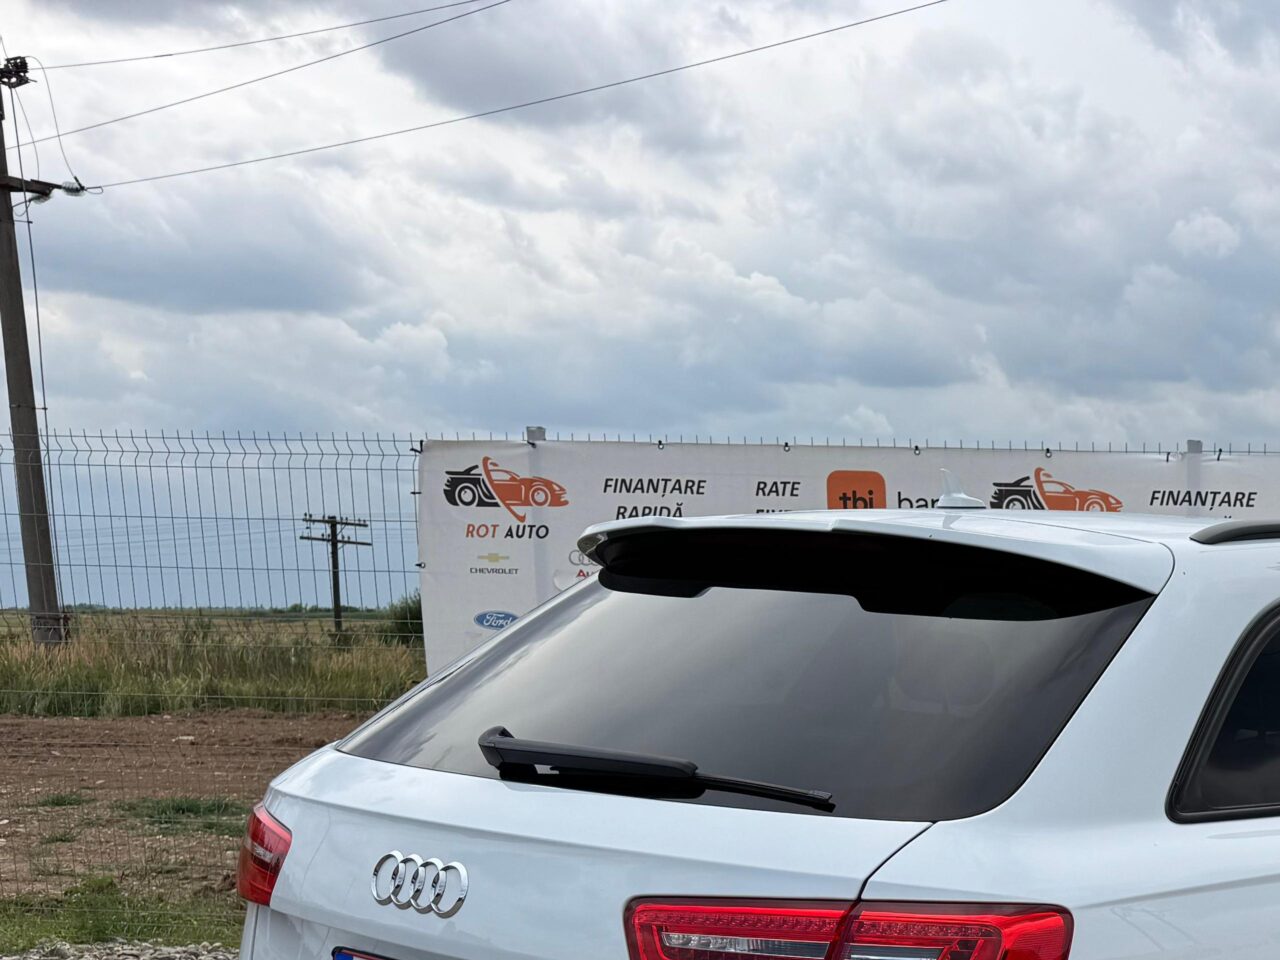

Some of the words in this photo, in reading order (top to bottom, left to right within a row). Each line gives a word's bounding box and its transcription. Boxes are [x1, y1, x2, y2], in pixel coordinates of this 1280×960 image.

[603, 478, 707, 498] FINANȚARE
[755, 481, 801, 497] RATE
[897, 491, 940, 509] ba
[1149, 490, 1258, 511] FINANȚARE
[465, 524, 497, 539] ROT
[504, 524, 550, 540] AUTO
[470, 567, 519, 575] CHEVROLET
